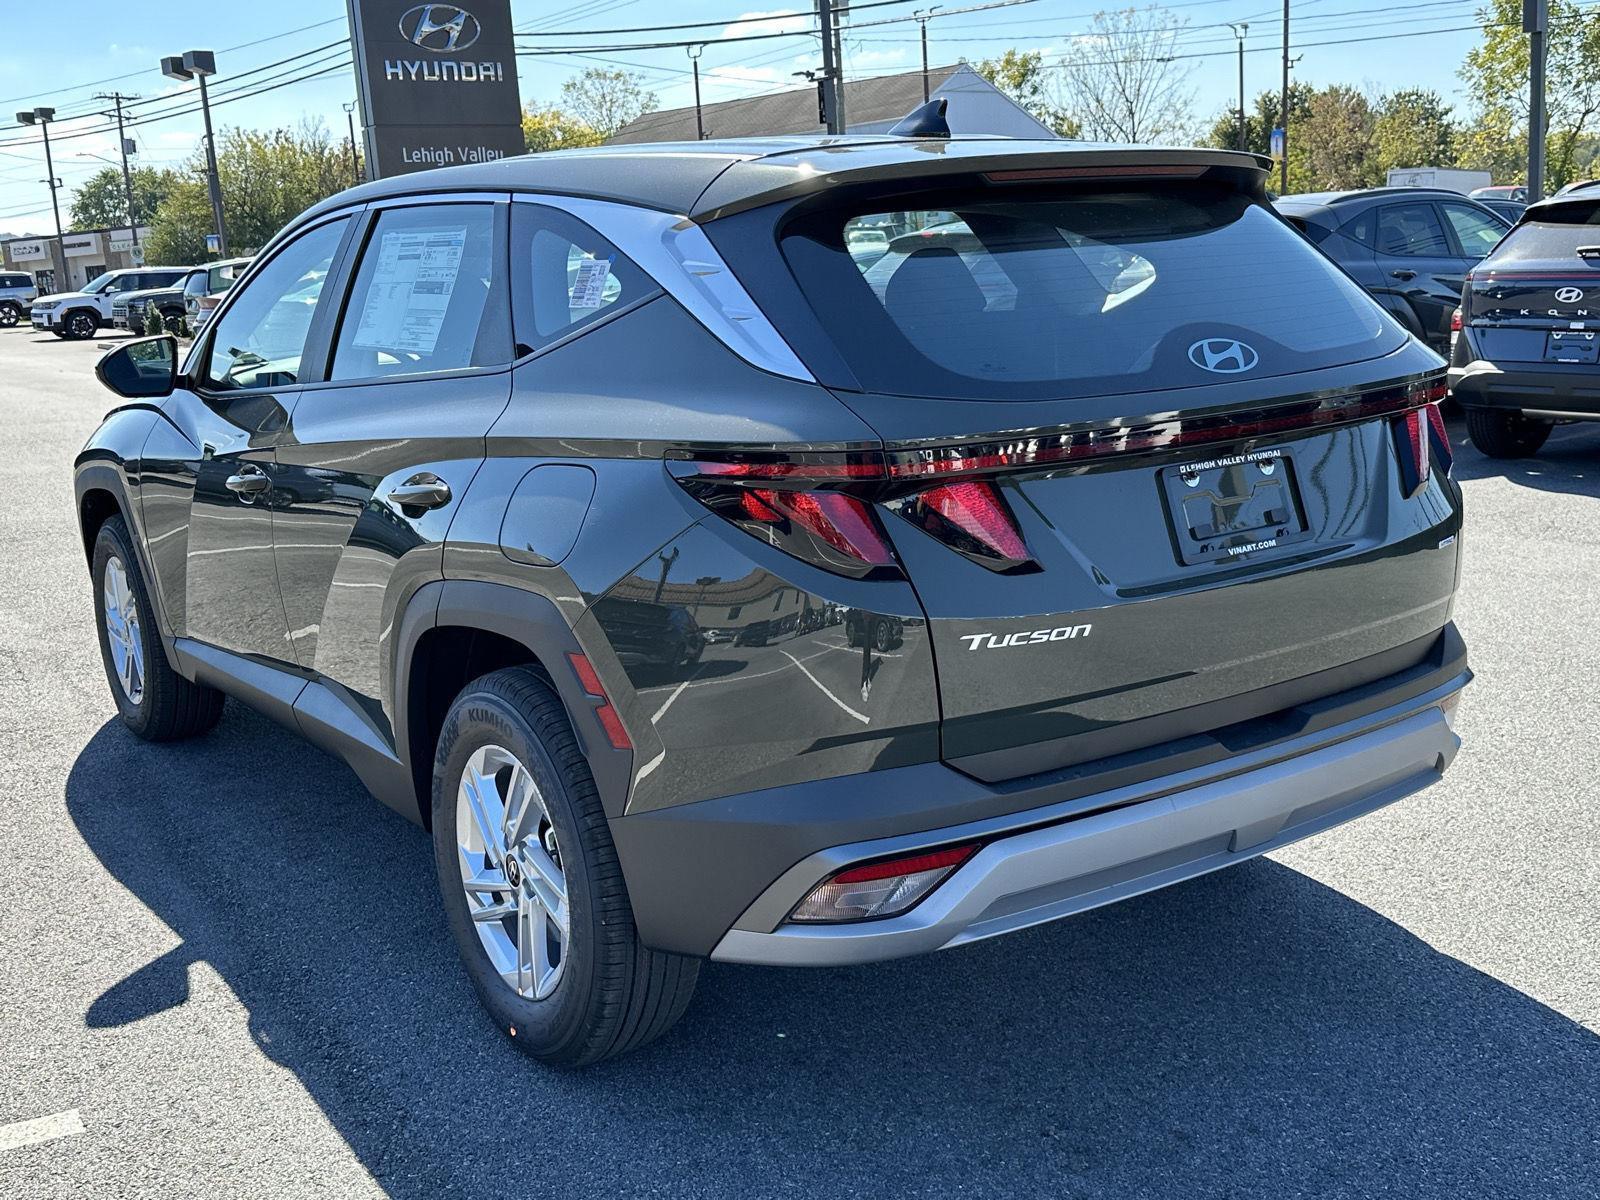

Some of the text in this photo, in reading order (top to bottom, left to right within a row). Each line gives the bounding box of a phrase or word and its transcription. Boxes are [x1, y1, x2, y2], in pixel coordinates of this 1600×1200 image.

[384, 60, 503, 81] HYUNDAI
[402, 147, 454, 166] Lehigh
[1186, 449, 1281, 472] LEHIGH VALLEY HYUNDAI
[1228, 539, 1277, 556] VINART.COM
[468, 708, 513, 739] KUMHO
